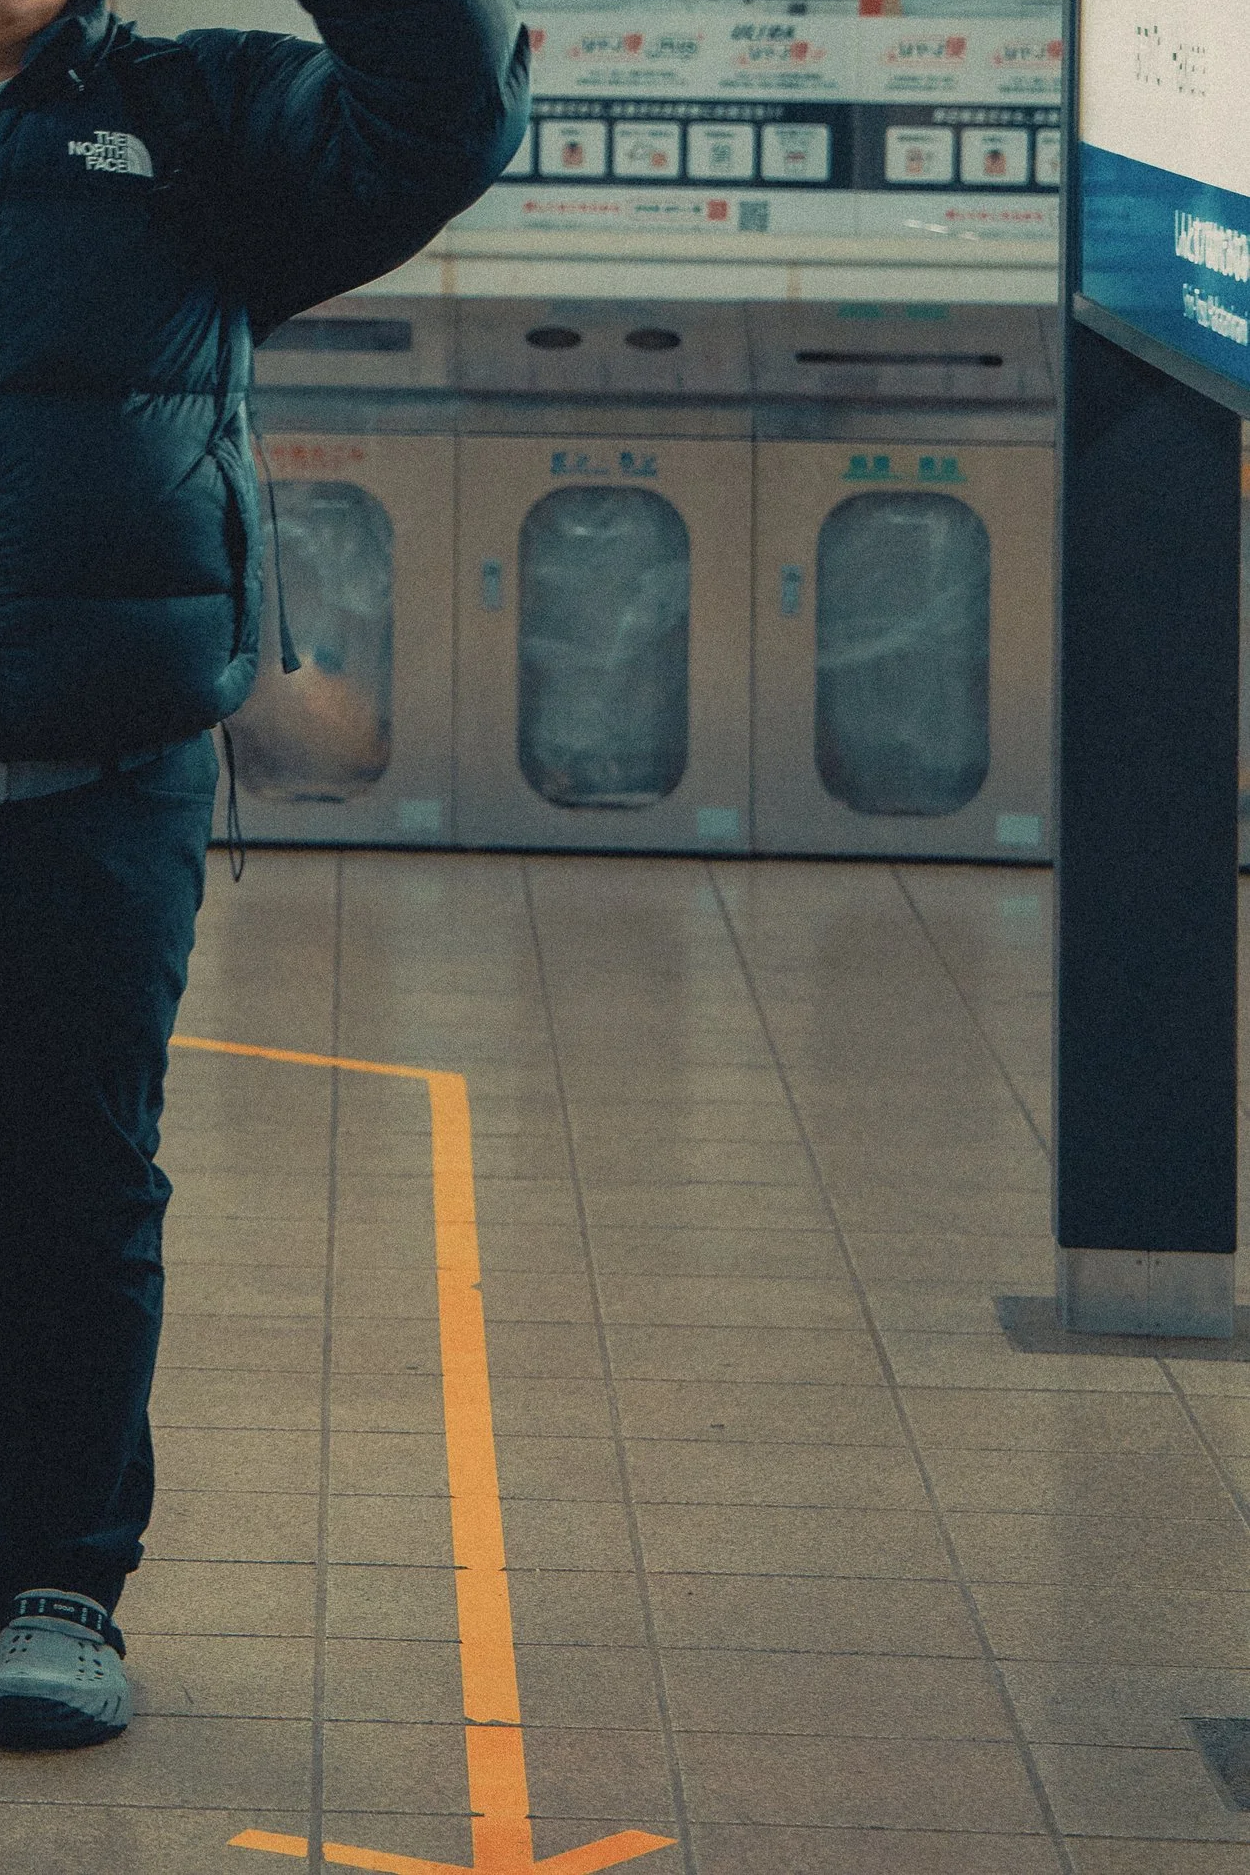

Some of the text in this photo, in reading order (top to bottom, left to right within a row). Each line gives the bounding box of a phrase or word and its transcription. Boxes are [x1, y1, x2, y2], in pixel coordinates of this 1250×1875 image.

[93, 130, 127, 144] THE
[68, 141, 126, 158] NORTH
[85, 156, 129, 173] FACE
